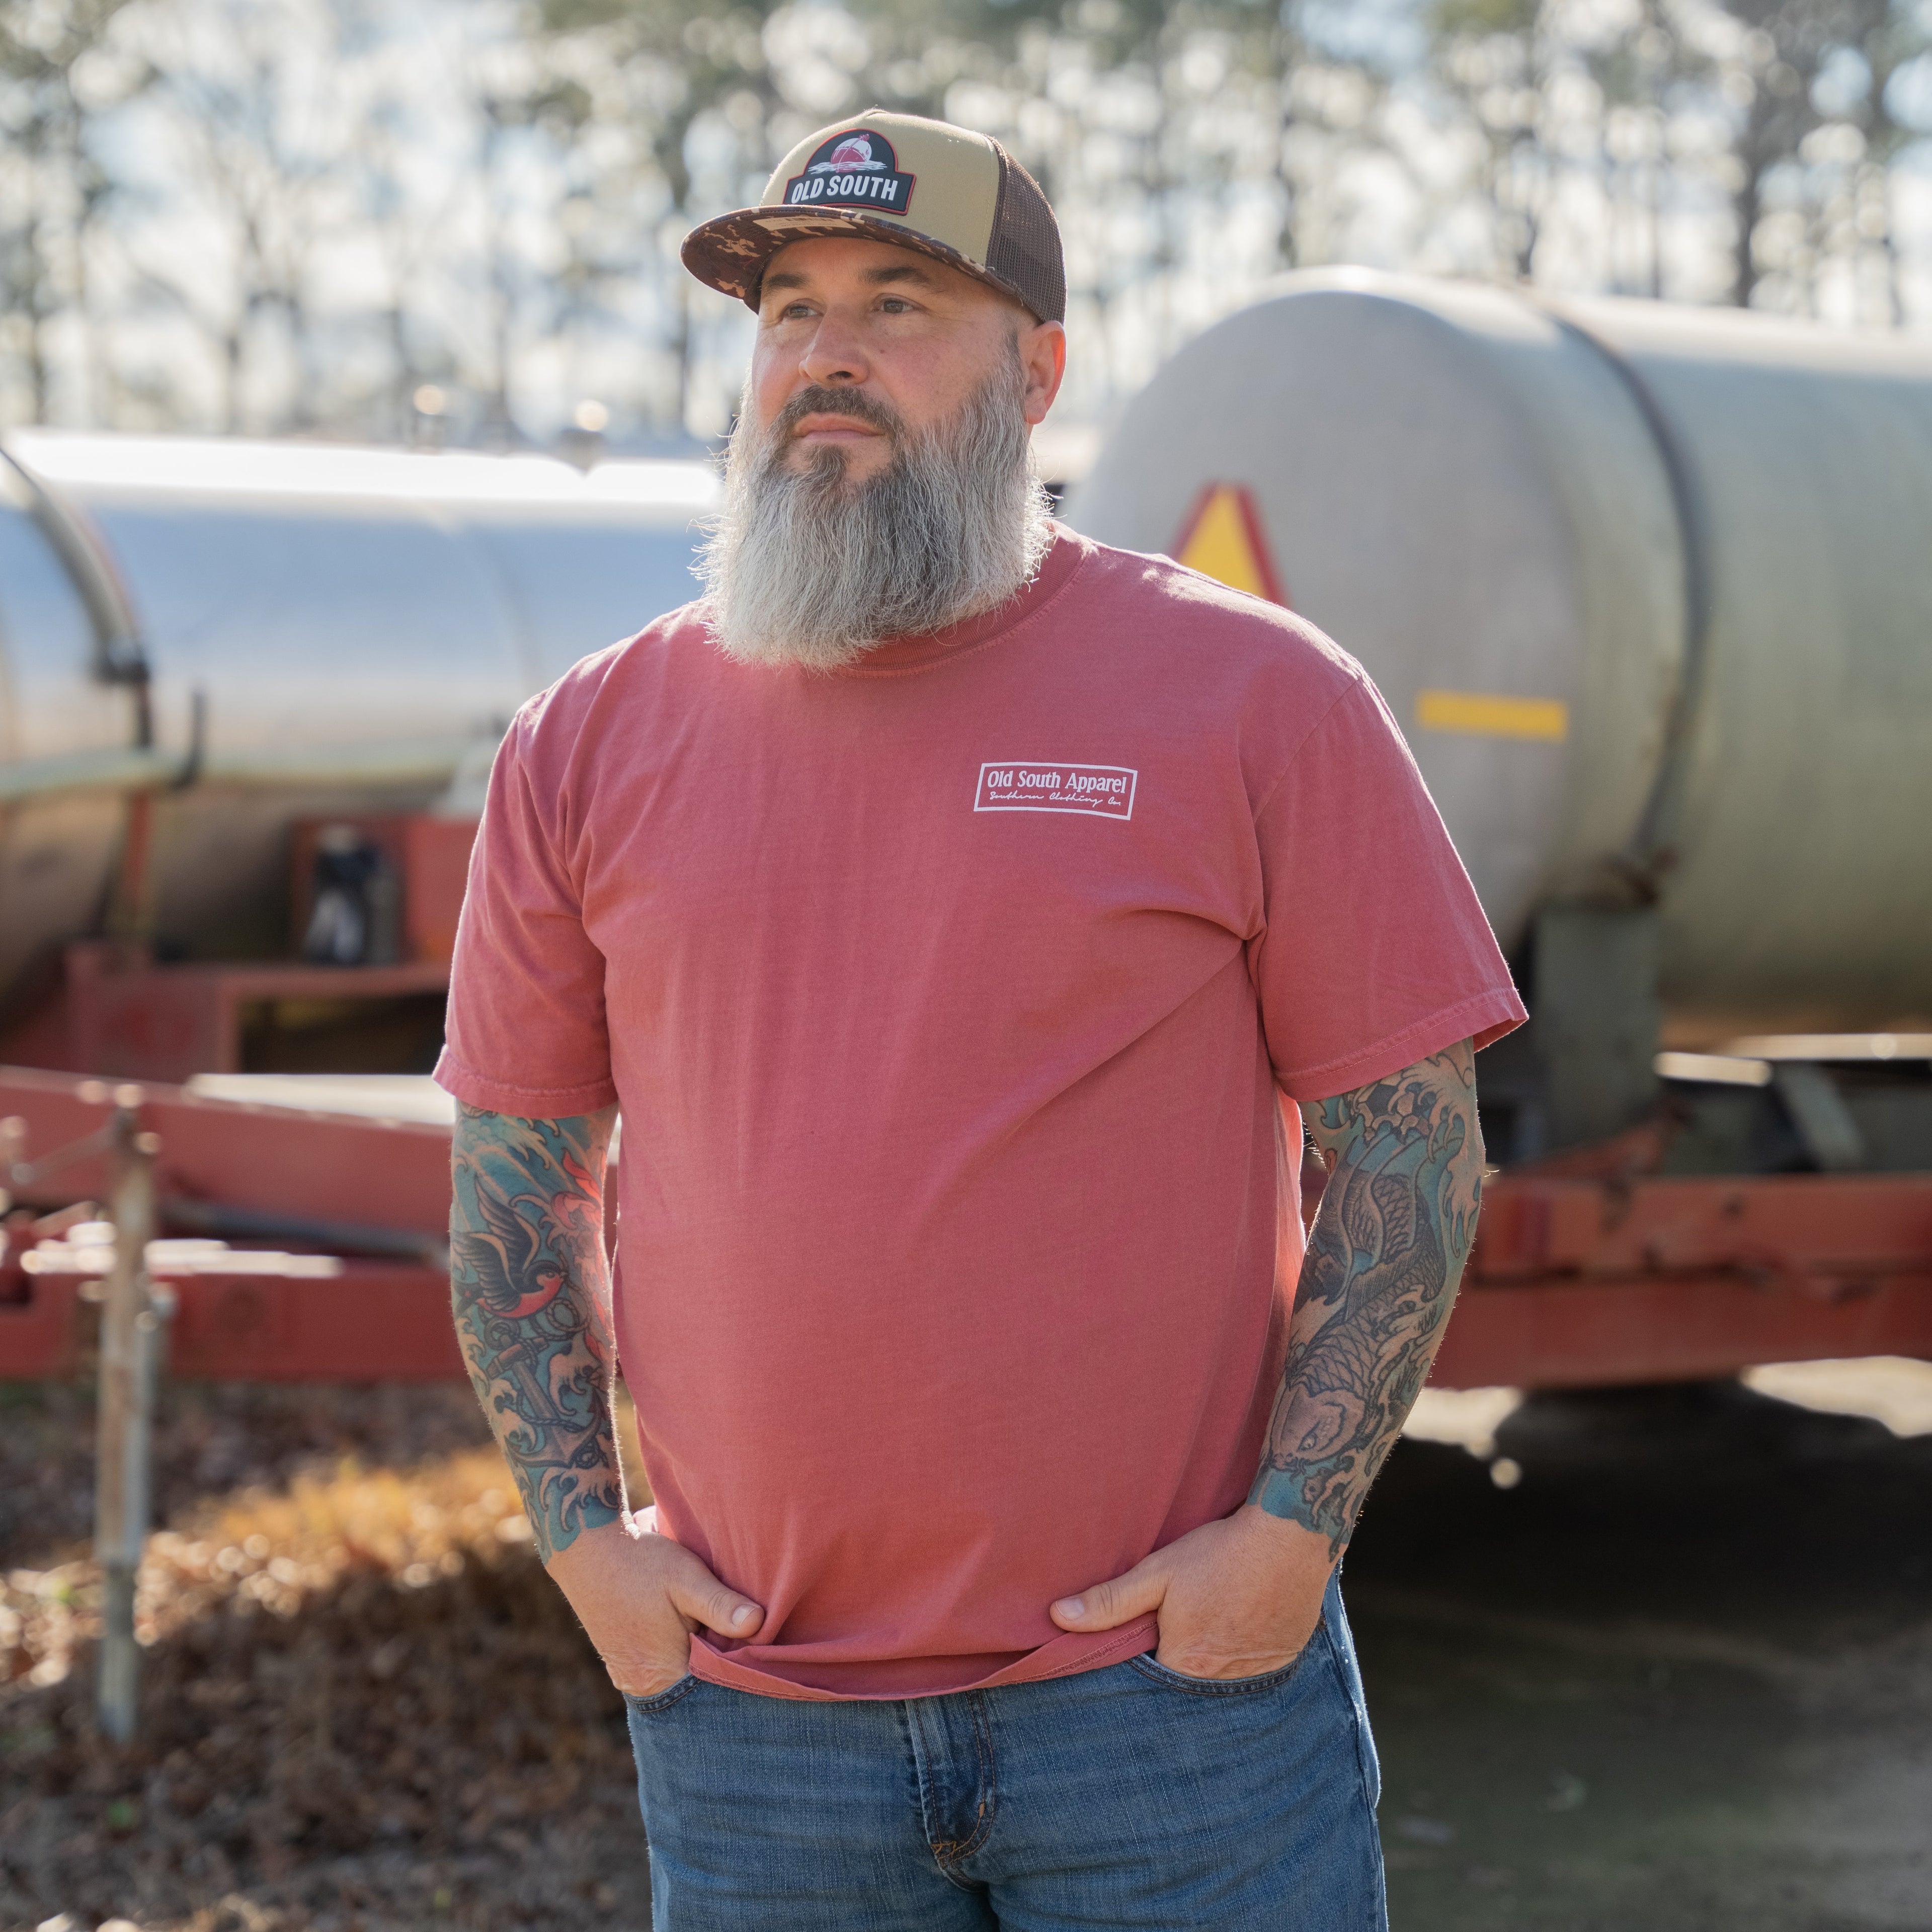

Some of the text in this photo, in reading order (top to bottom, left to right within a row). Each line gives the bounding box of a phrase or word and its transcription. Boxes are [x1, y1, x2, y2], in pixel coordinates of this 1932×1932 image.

[791, 175, 898, 204] OLD SOUTH
[988, 770, 1127, 793] Old South Apparel
[989, 790, 1044, 800] Southern
[1049, 791, 1103, 808] Clothing
